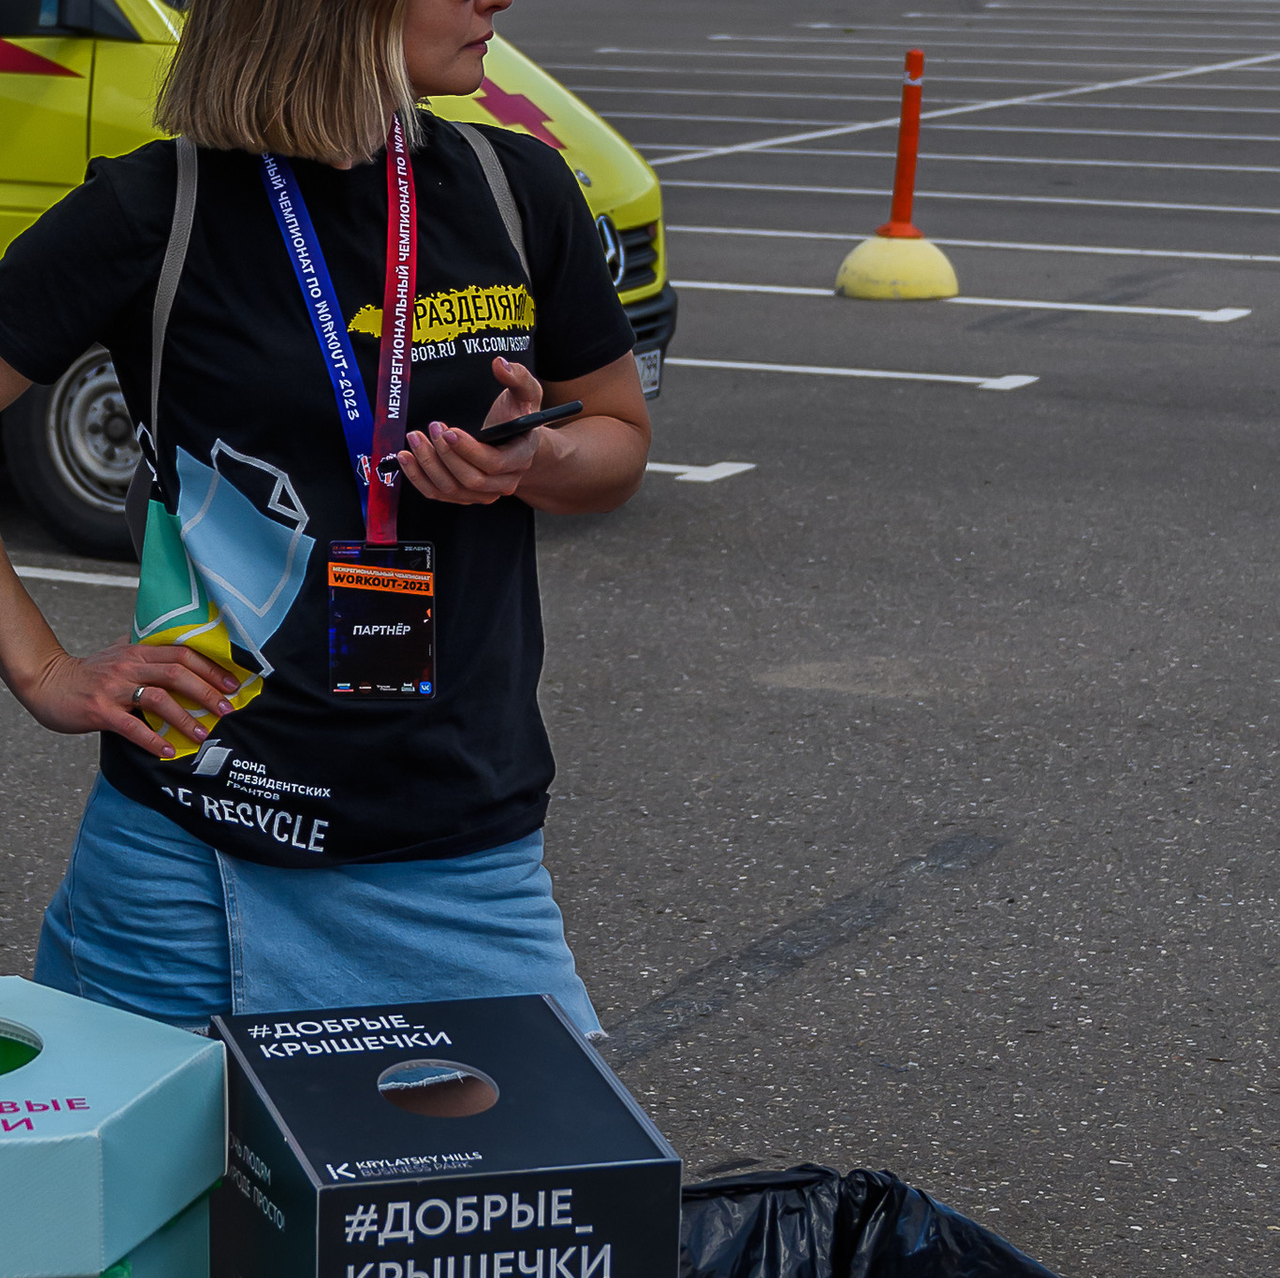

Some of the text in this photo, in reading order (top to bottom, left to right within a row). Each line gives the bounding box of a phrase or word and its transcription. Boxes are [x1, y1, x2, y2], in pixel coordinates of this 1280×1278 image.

[396, 156, 408, 176] ПО
[397, 177, 411, 262] ЧЕМПИОНАТ
[277, 190, 360, 421] ЧЕМПИОНАТ ПО WORKOUT-2023
[387, 266, 411, 419] МЕЖРЕГИОНАЛЬНЫЙ
[332, 573, 430, 591] WORKOUT-2023
[352, 622, 411, 636] ПАРТНЁР
[232, 758, 266, 774] ФОНД
[228, 770, 332, 798] ПРЕЗИДЕНТСКИХ
[201, 794, 329, 852] RECYCLE
[259, 1031, 453, 1058] КРЫШЕЧКИ
[355, 1154, 439, 1170] KRYLATSKY
[441, 1151, 483, 1162] HILLS
[360, 1163, 432, 1178] BUSINESS
